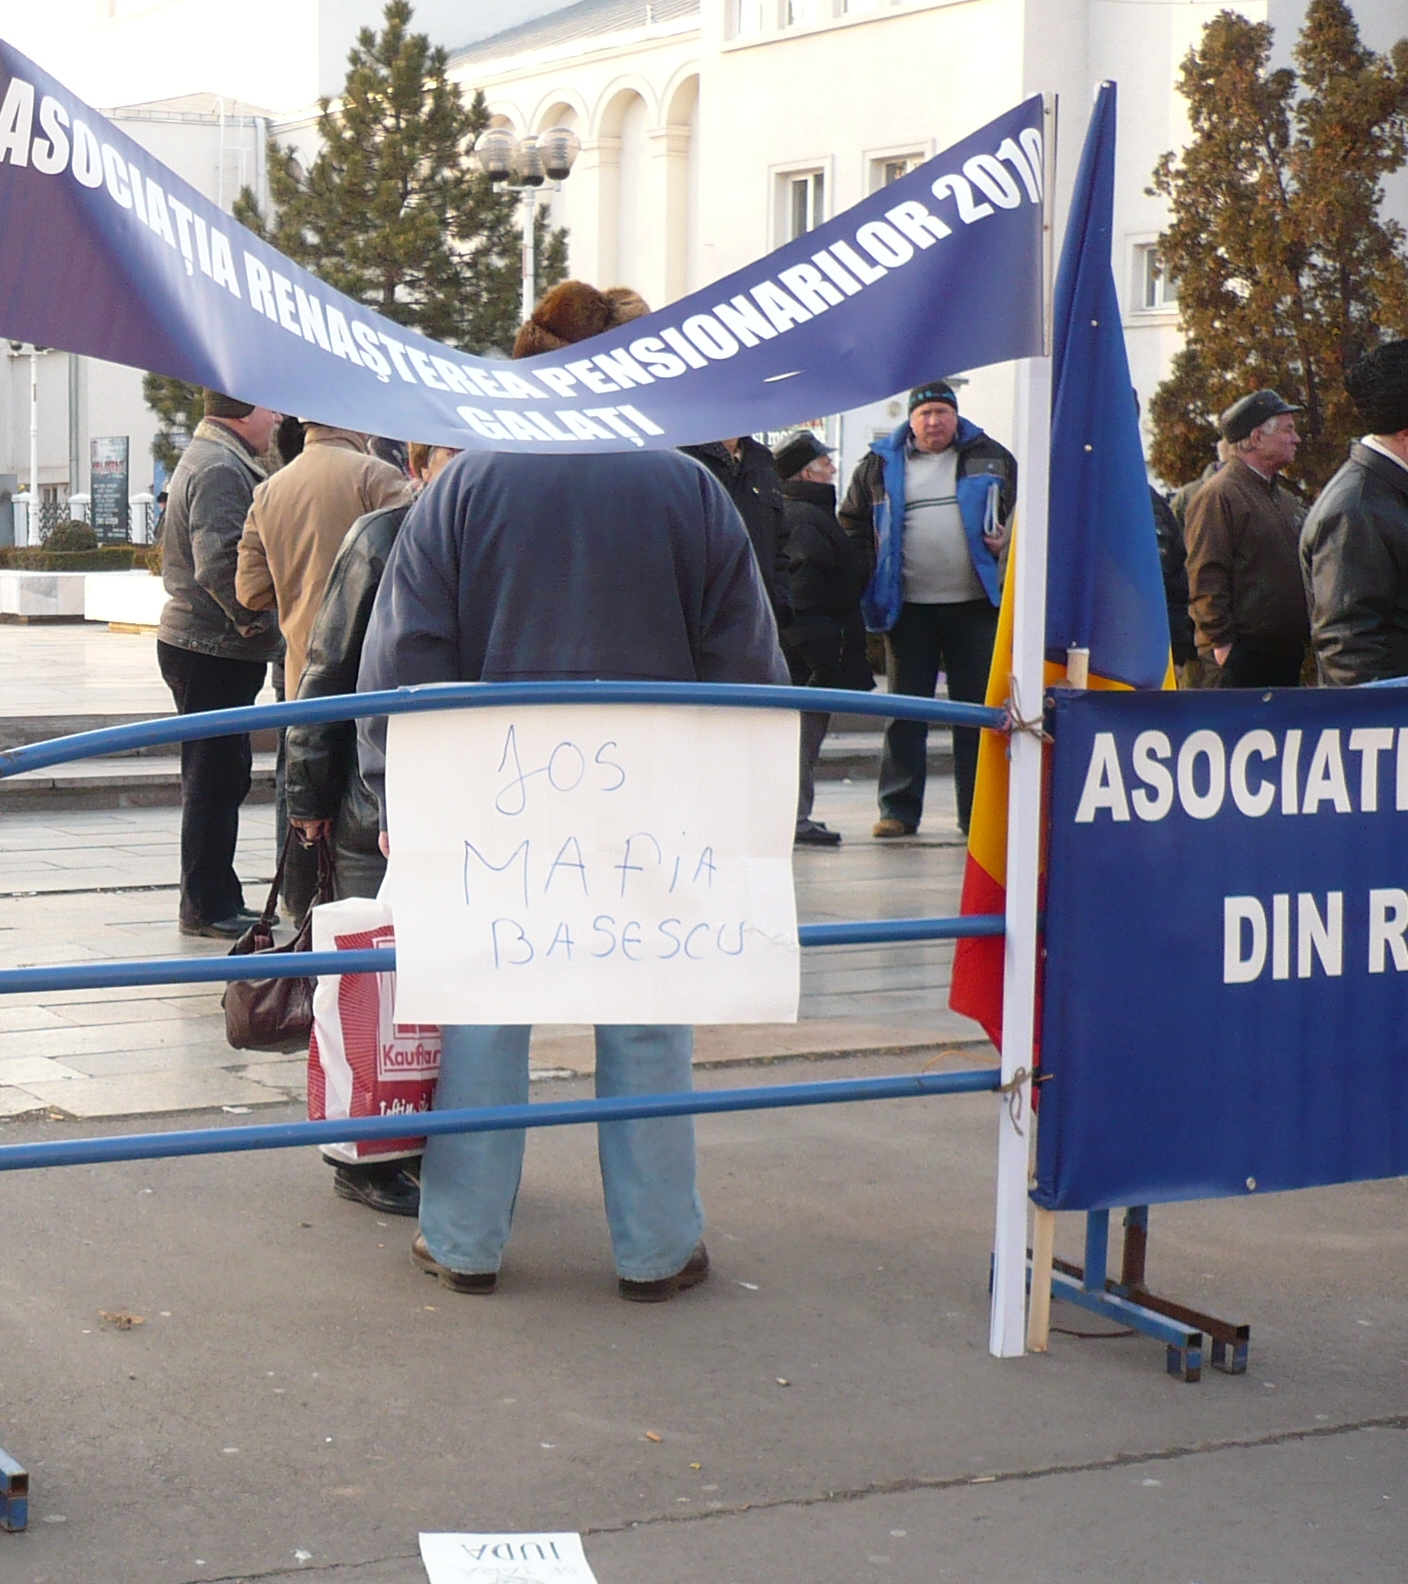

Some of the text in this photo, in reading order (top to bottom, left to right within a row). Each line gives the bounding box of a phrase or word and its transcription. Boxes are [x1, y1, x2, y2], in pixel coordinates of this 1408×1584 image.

[531, 200, 953, 394] PENSIONARILOR
[931, 128, 1044, 224] 2010
[492, 915, 745, 969] BASESCU
[1223, 891, 1343, 984] DIN
[461, 1541, 560, 1560] IUDA
